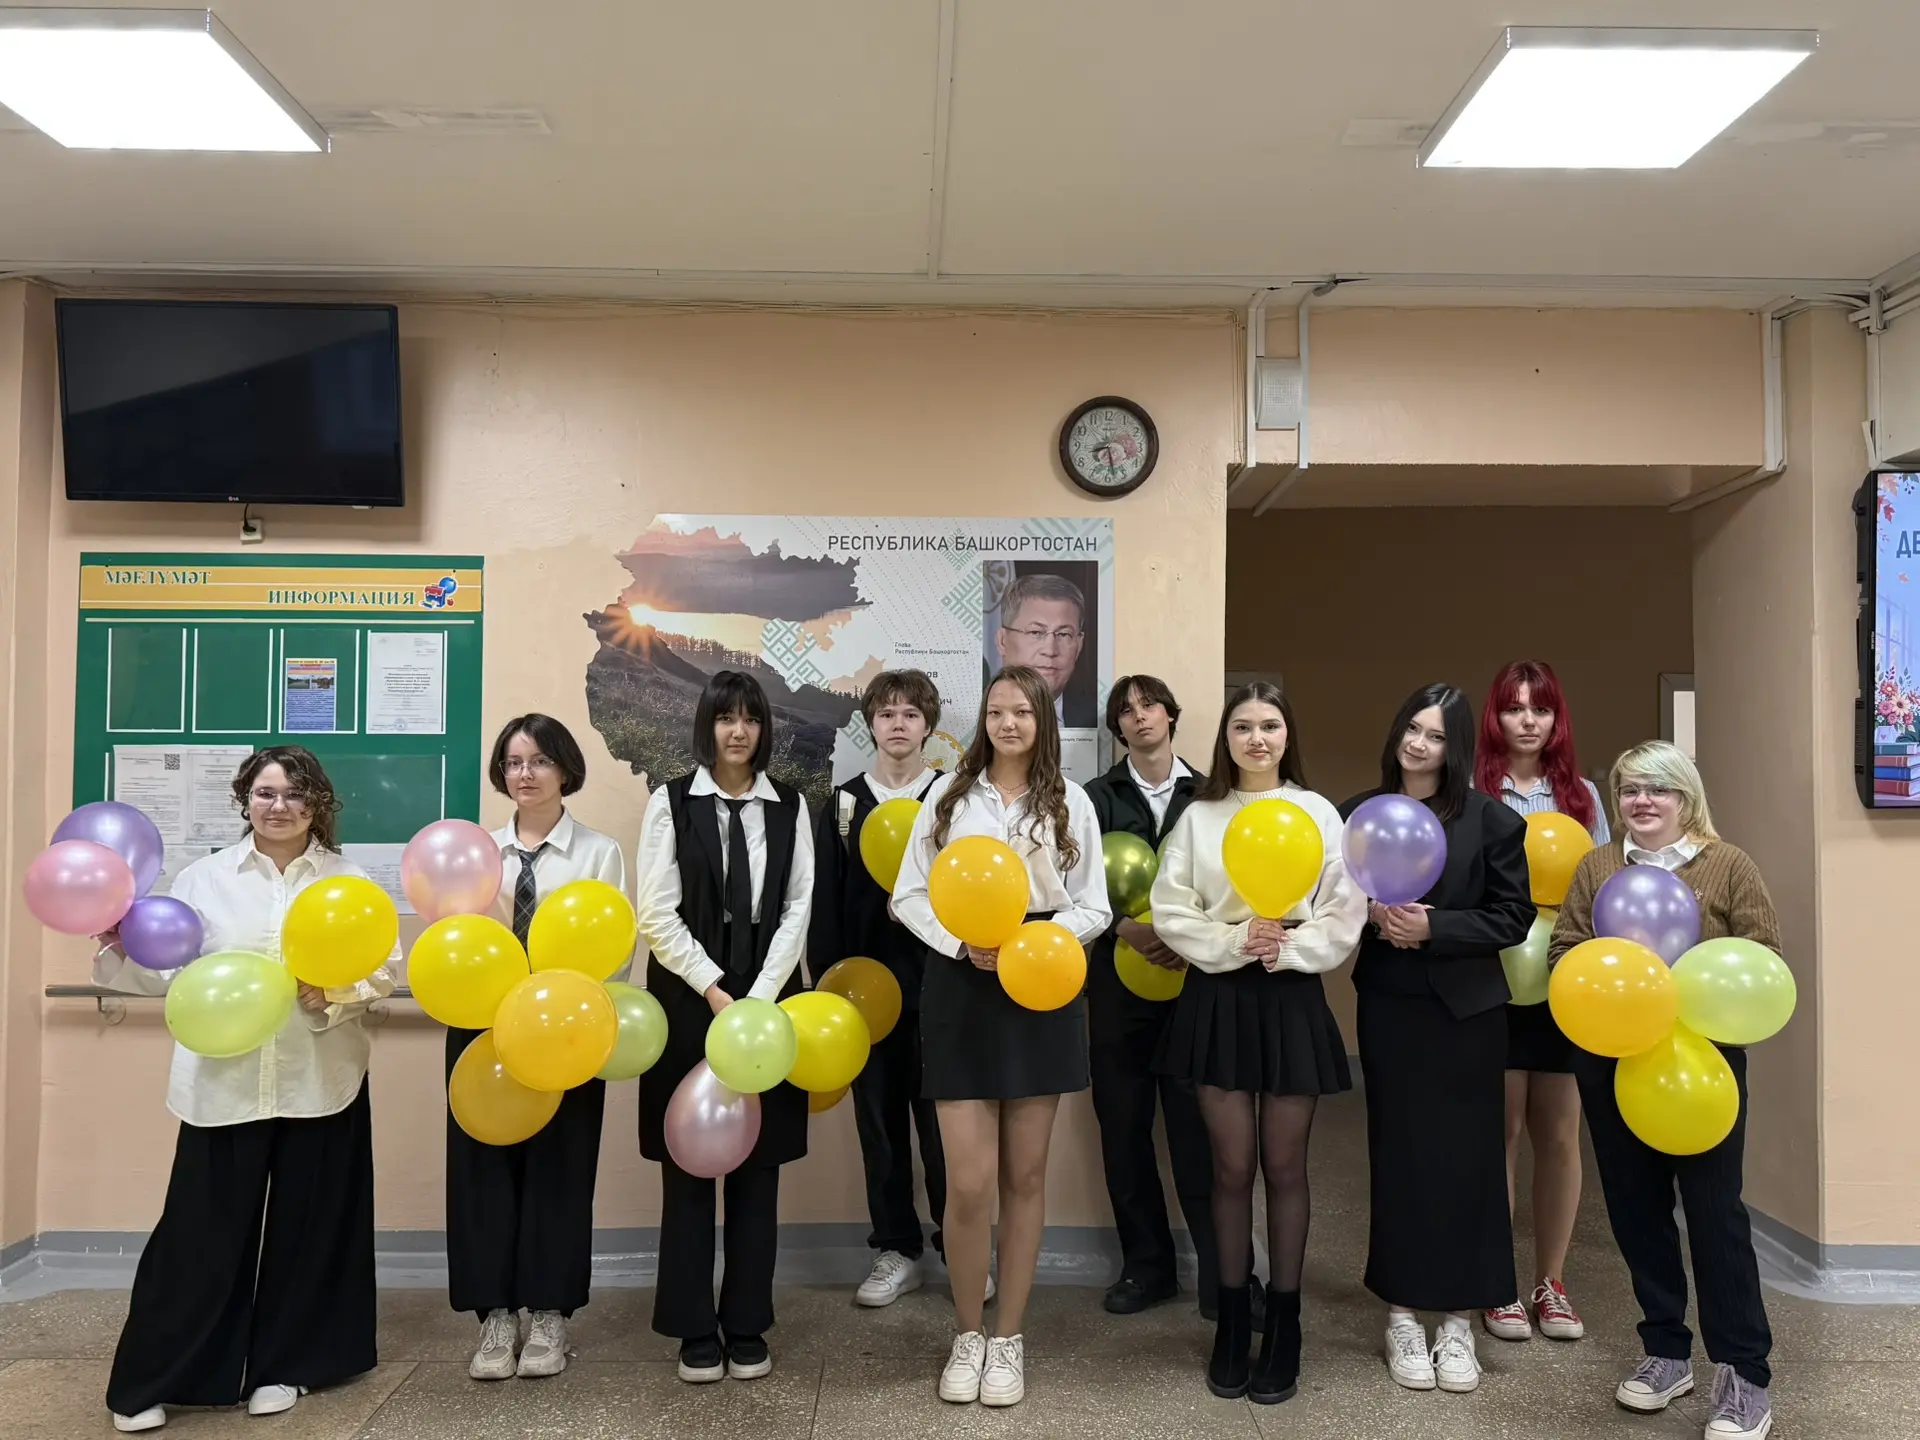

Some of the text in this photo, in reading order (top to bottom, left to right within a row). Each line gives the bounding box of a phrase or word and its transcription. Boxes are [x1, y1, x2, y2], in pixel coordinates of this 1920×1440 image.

[1090, 414, 1098, 425] 11
[1104, 410, 1114, 422] 12
[1122, 415, 1127, 425] 1
[1132, 427, 1140, 437] 2
[1074, 441, 1081, 452] 9
[1136, 442, 1143, 453] 3
[1077, 457, 1085, 467] 8
[1132, 458, 1138, 468] 4
[1104, 473, 1111, 483] 6
[828, 535, 1097, 551] РЕСПУБЛИКА БАШКОРТОСТАН
[267, 590, 415, 606] ИНФОРМАЦИЯ
